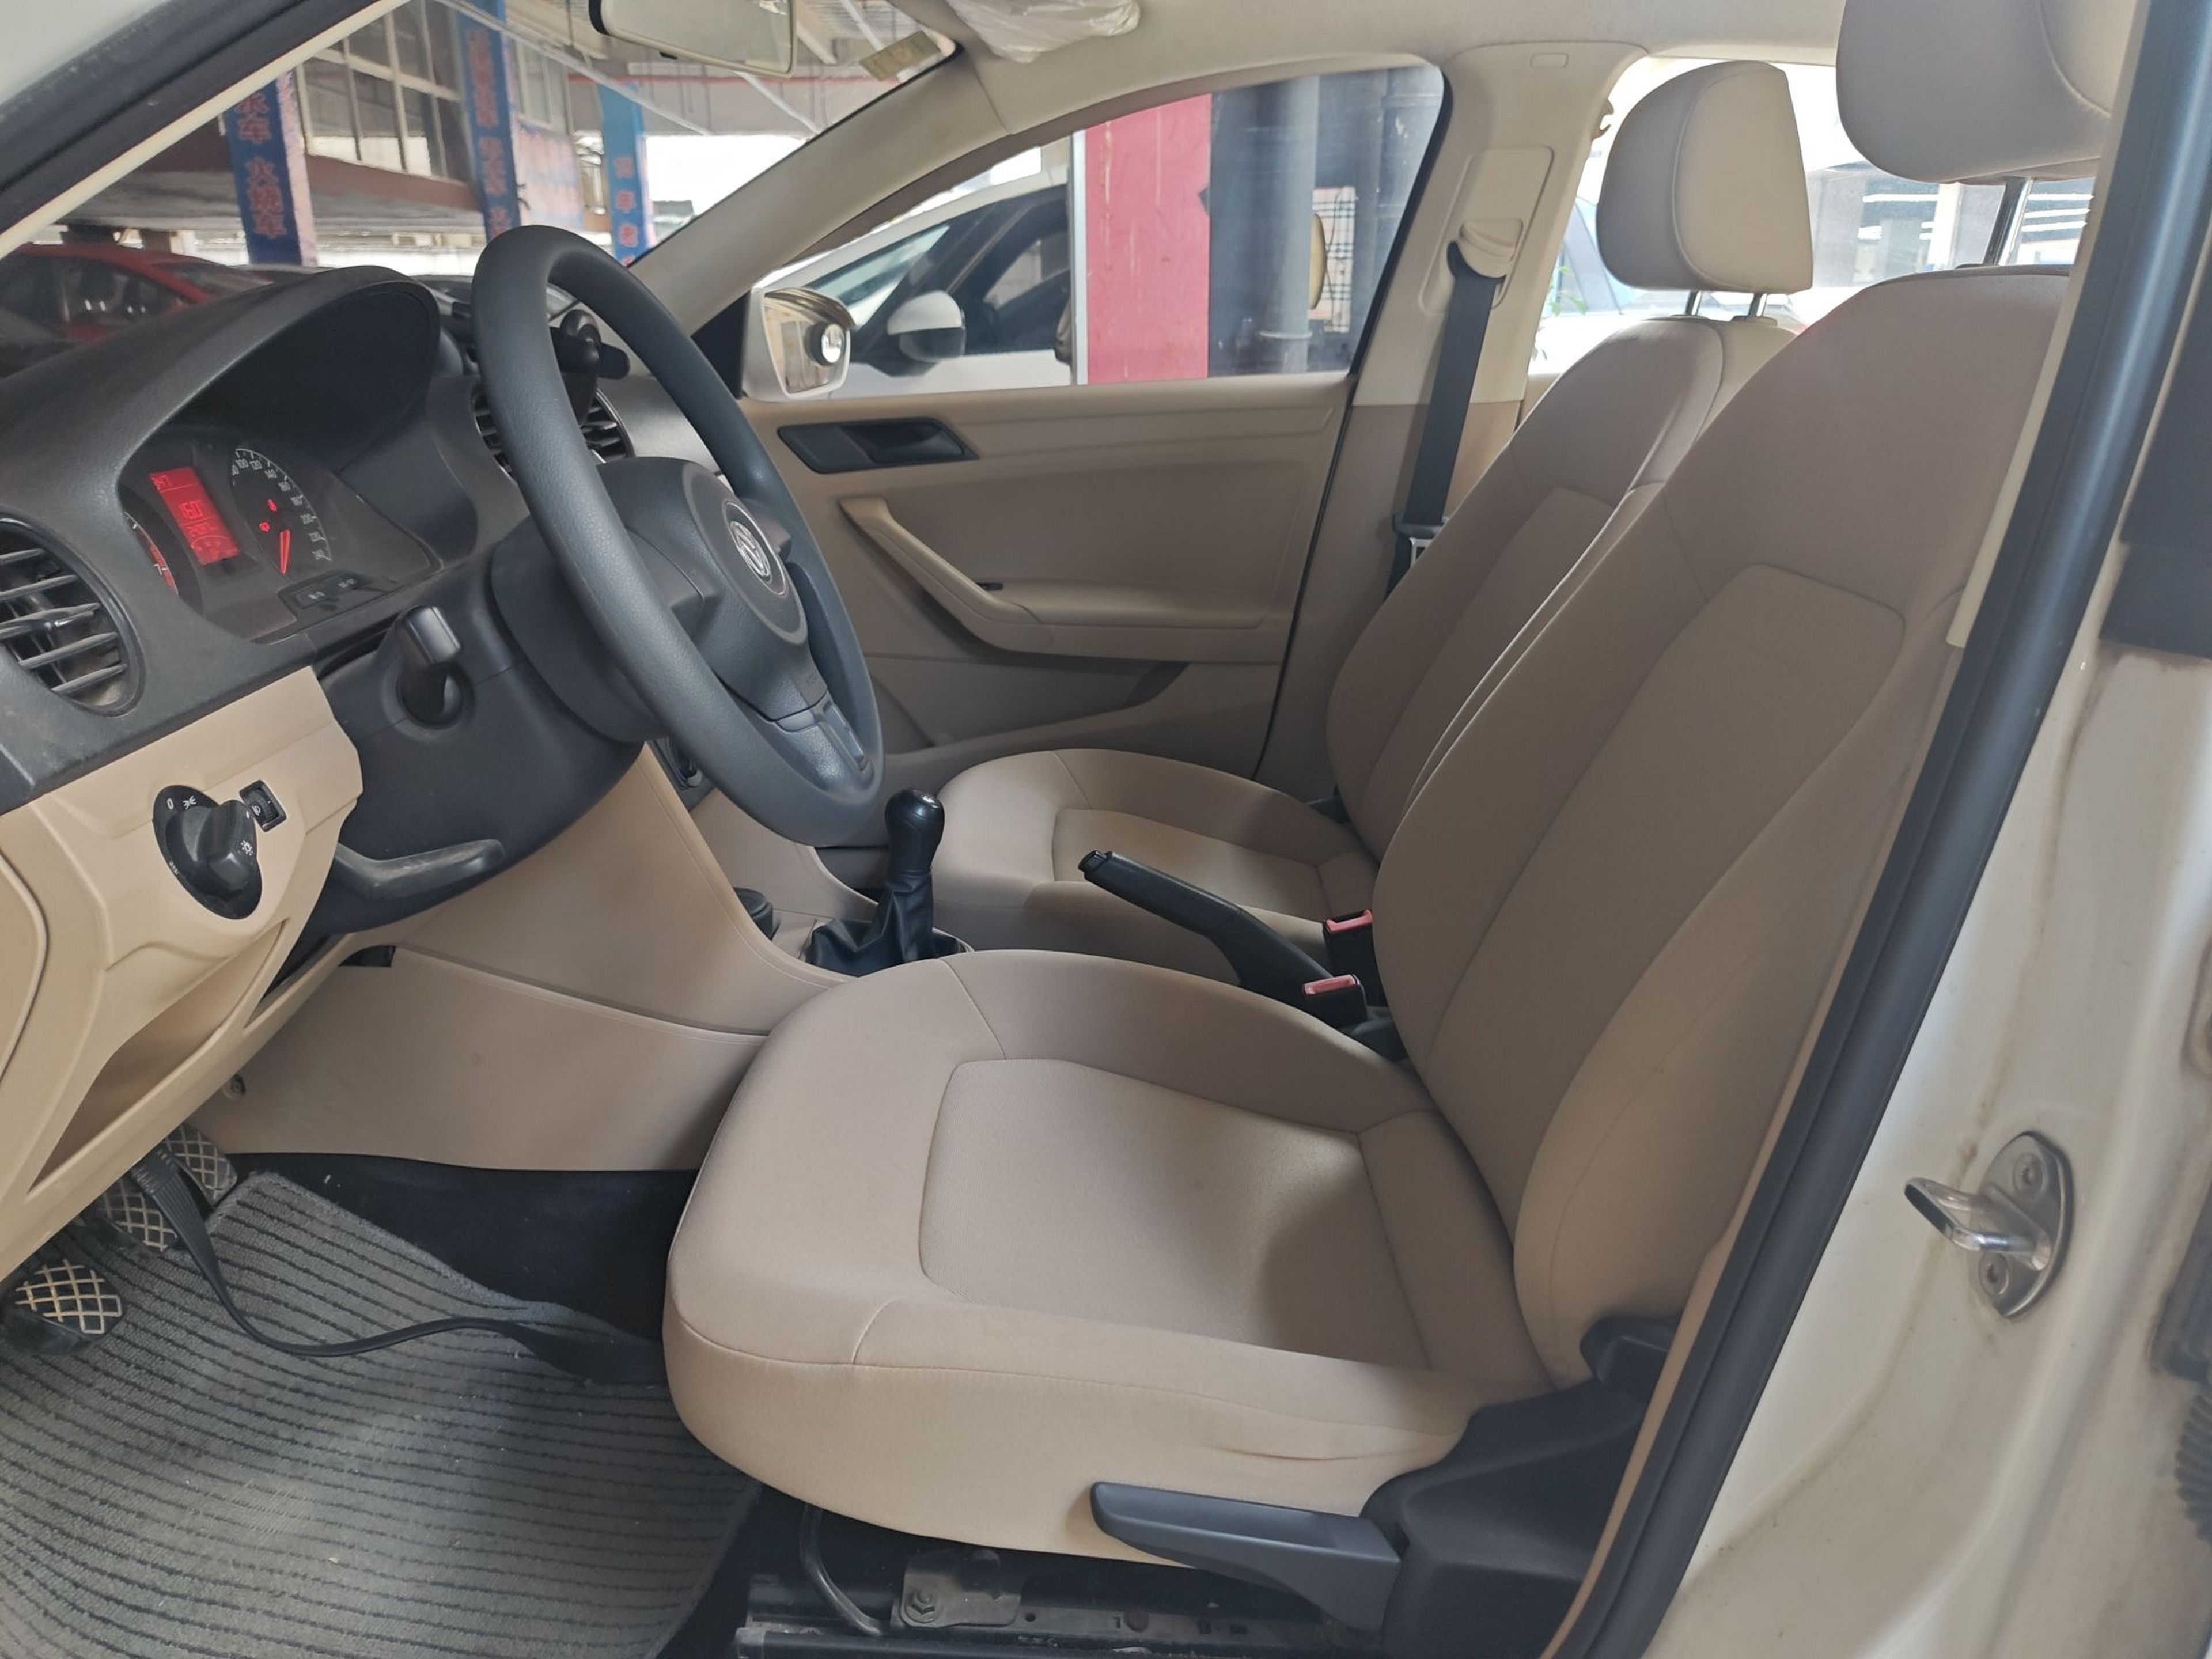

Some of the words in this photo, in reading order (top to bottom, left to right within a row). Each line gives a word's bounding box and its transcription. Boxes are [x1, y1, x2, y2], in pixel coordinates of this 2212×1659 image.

[235, 458, 249, 468] 100
[249, 460, 263, 470] 120
[264, 469, 277, 479] 140
[278, 481, 291, 492] 160
